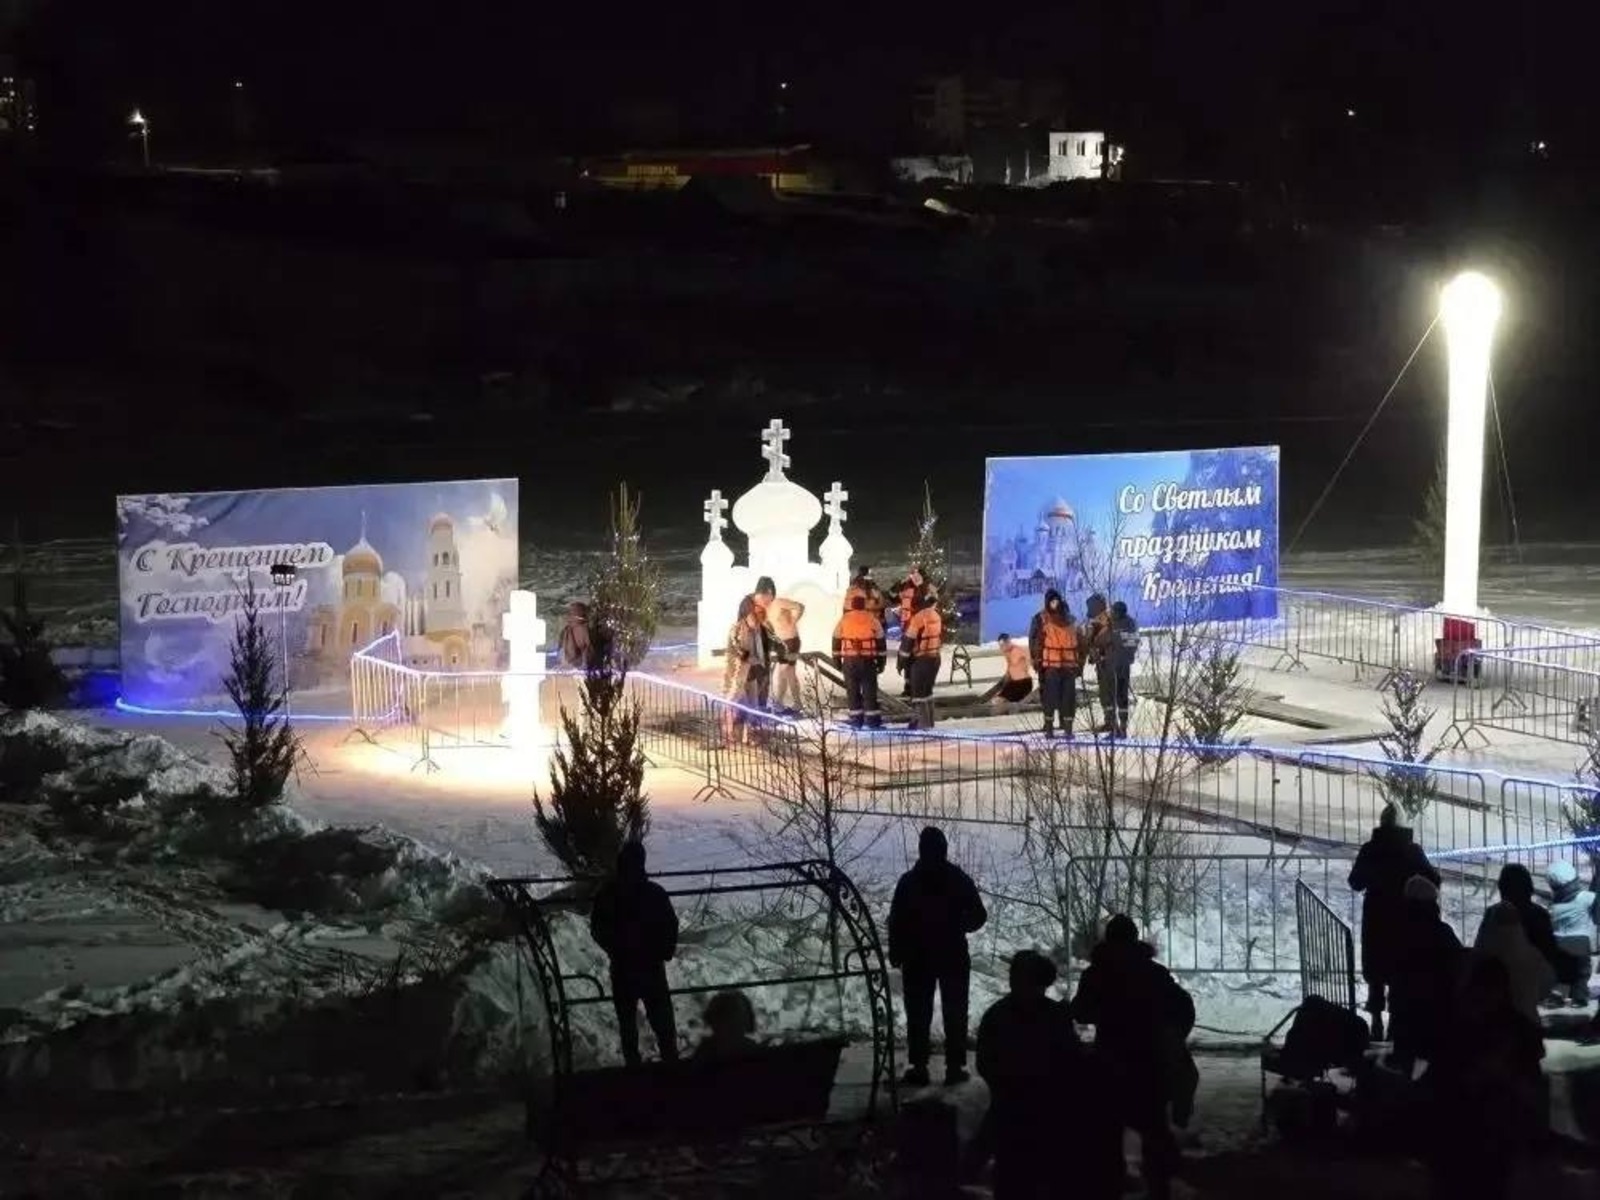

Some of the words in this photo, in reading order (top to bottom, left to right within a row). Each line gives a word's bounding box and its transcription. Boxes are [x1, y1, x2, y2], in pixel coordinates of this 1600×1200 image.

[1120, 485, 1145, 513] Со
[1152, 483, 1261, 512] Светлым
[136, 549, 157, 571] С
[166, 546, 325, 576] Крещением
[1120, 530, 1261, 563] праздником
